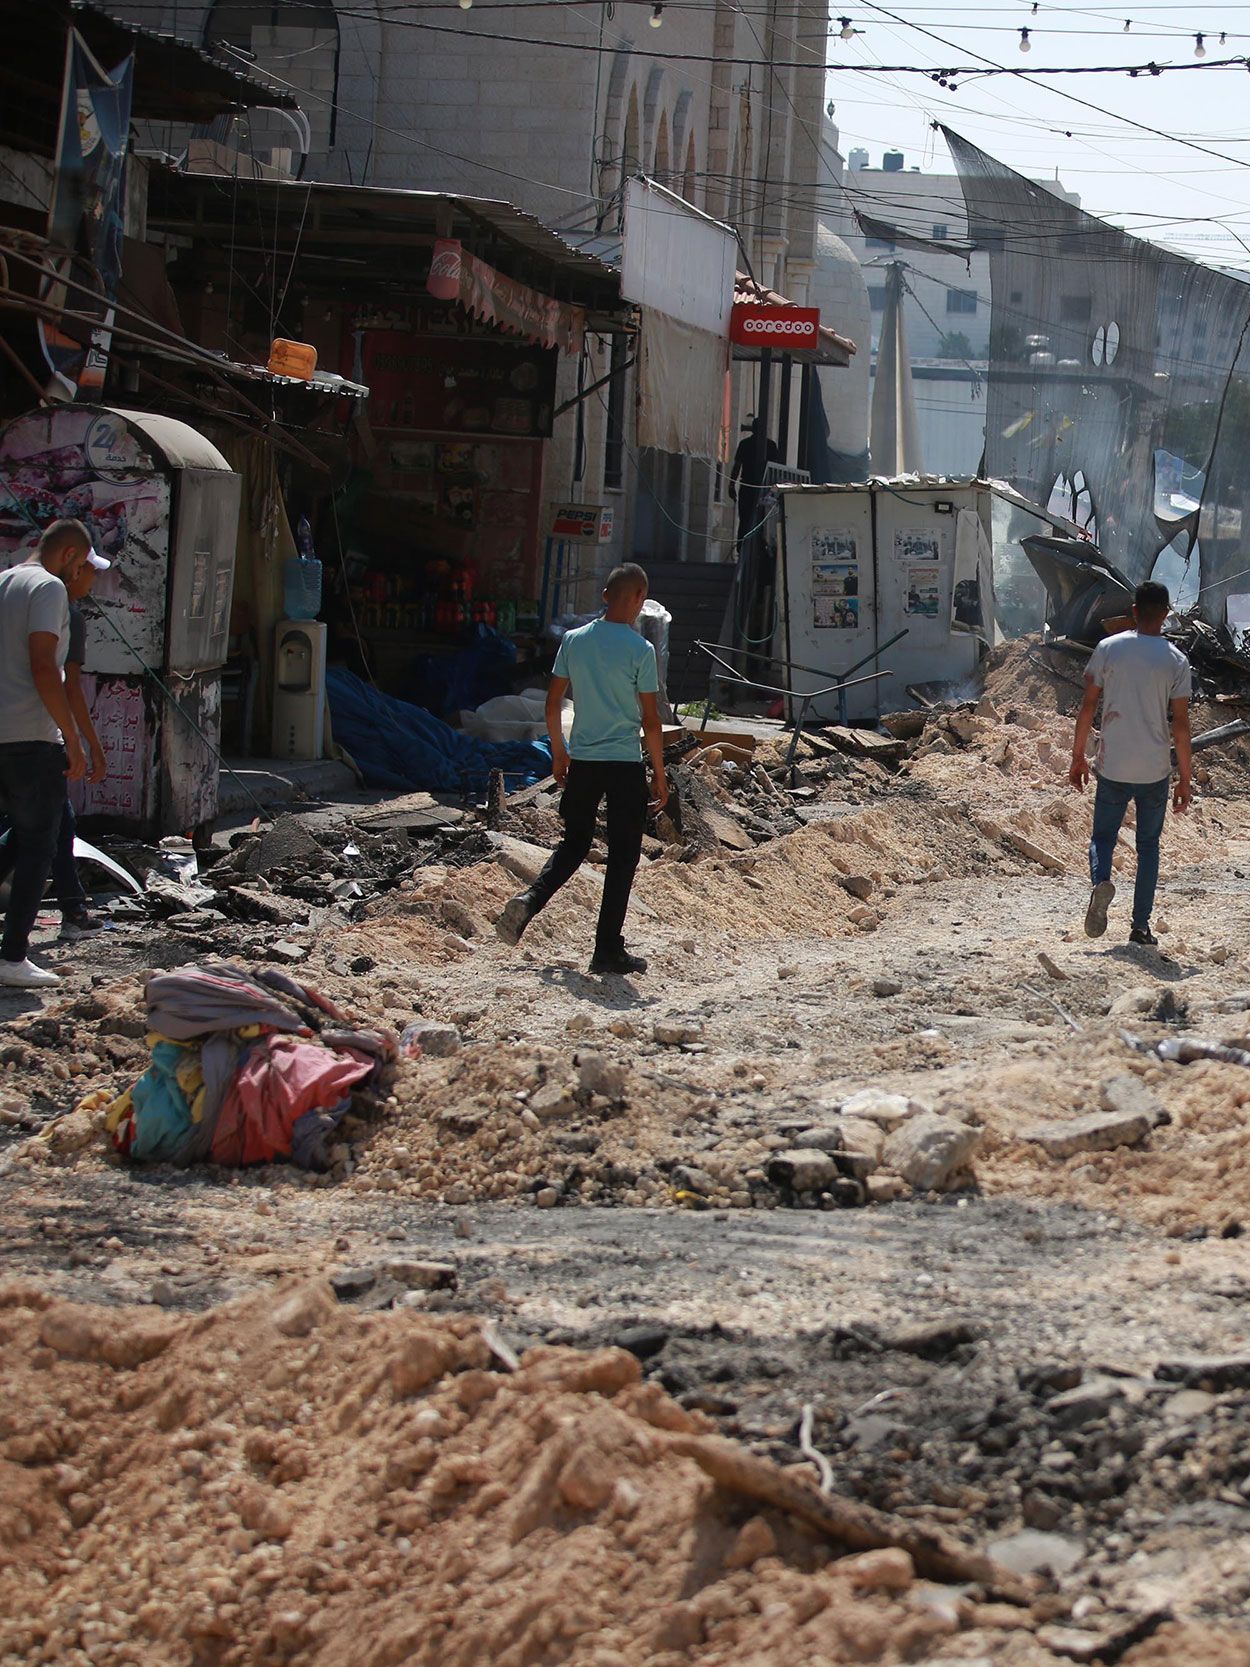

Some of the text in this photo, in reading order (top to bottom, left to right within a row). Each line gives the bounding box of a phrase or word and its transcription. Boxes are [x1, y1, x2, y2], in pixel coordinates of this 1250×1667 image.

[744, 319, 814, 334] ooredoo
[105, 452, 127, 463] خدمة
[557, 509, 597, 522] PEPSI
